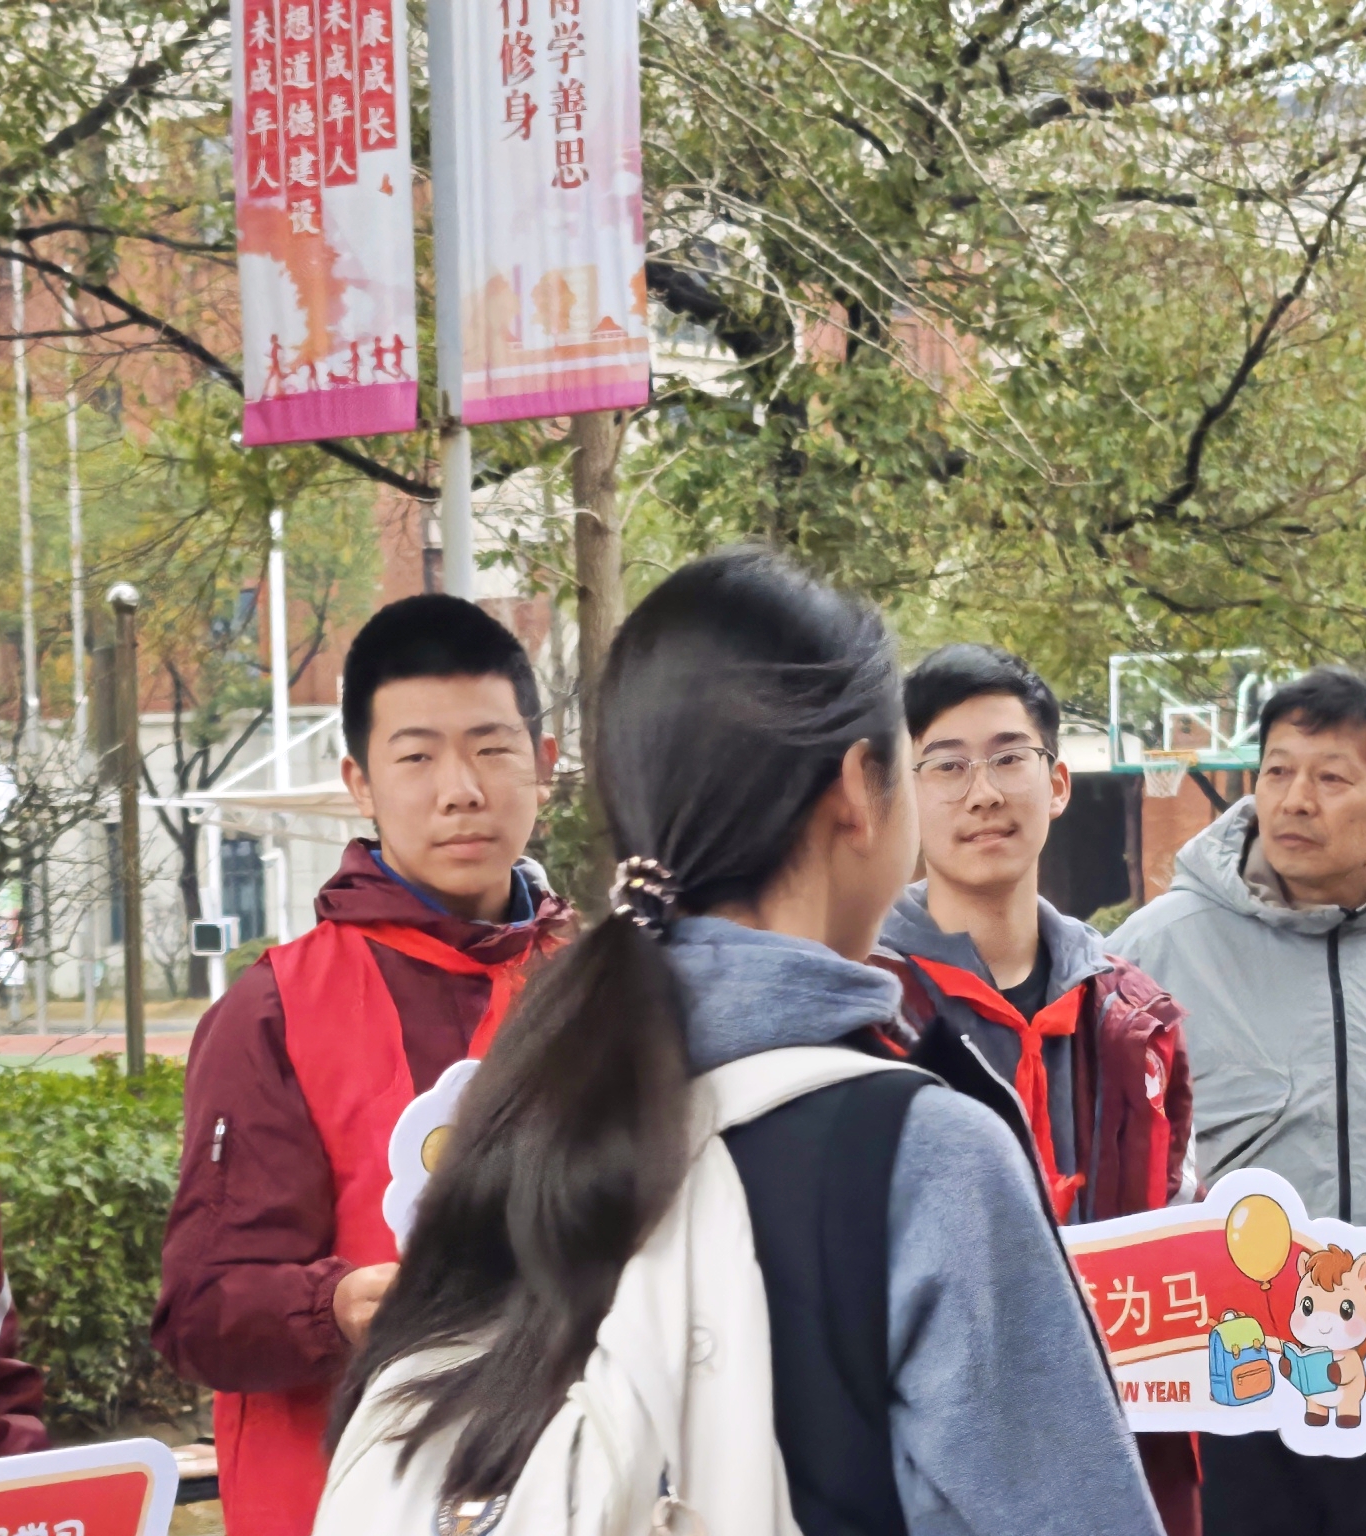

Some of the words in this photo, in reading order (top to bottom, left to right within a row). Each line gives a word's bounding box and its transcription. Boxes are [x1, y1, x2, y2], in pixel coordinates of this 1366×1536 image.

[247, 10, 280, 190] 未成年人
[284, 4, 320, 235] 想道德建设
[1143, 1381, 1191, 1402] YEAR
